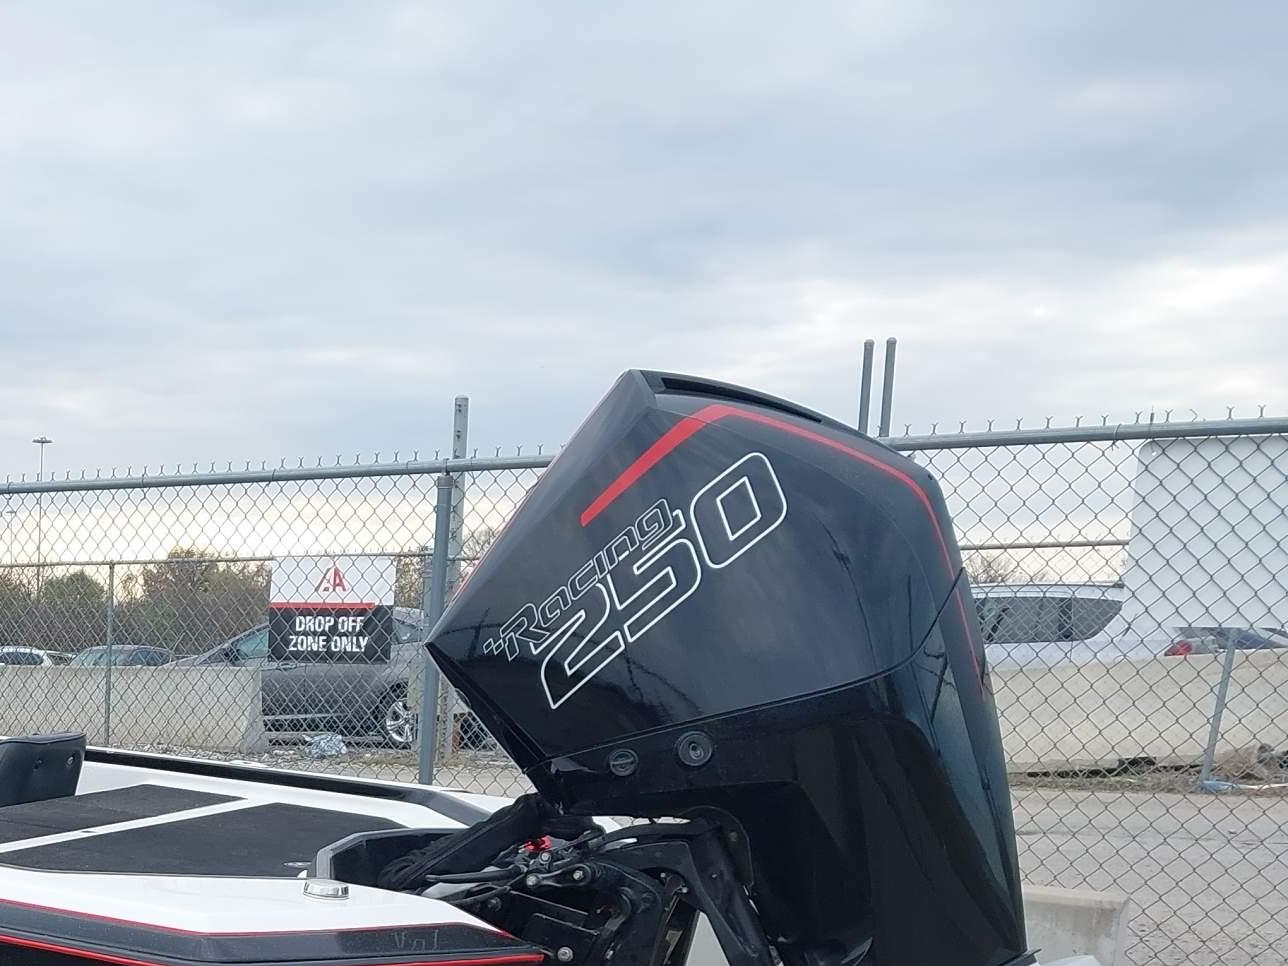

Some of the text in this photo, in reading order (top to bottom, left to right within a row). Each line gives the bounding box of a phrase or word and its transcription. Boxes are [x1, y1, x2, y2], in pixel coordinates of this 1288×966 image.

[295, 615, 364, 633] DROP OFF
[499, 498, 674, 662] Racing
[540, 452, 788, 709] 250
[288, 635, 369, 652] ZONE ONLY
